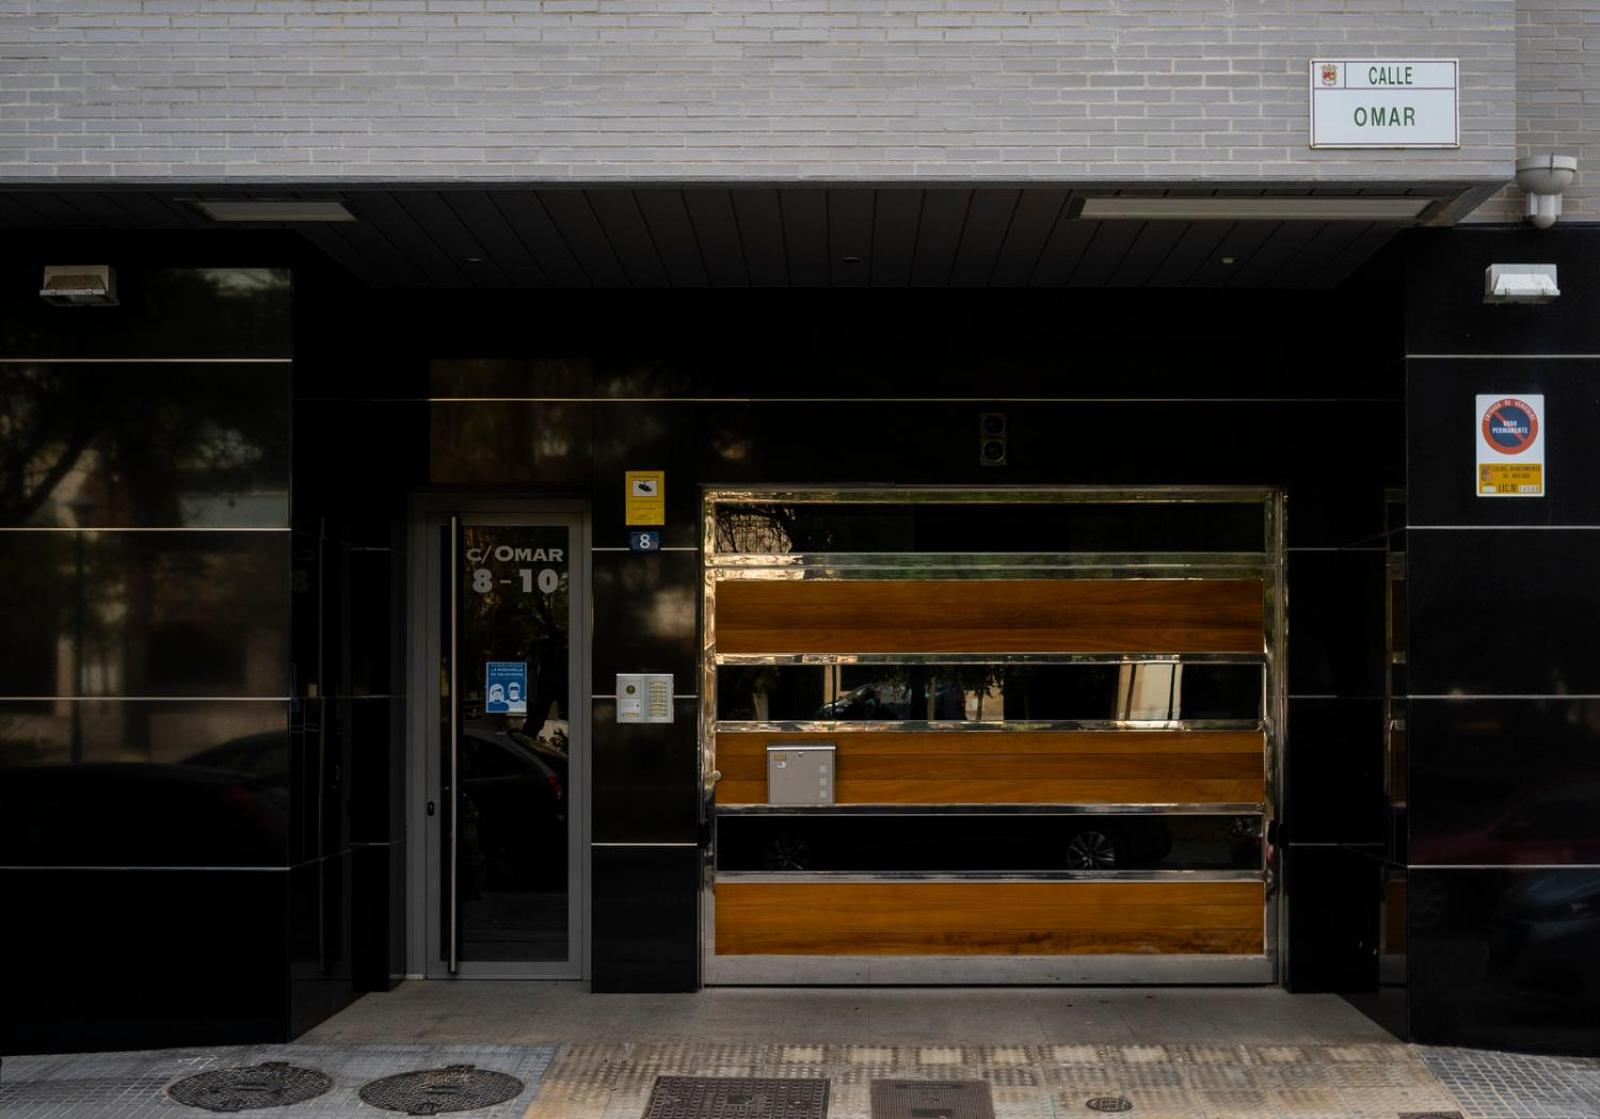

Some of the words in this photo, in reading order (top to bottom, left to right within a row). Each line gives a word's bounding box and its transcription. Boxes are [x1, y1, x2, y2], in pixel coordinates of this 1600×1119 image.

[1368, 66, 1413, 85] CALLE
[1353, 106, 1415, 127] OMAR
[639, 533, 651, 550] 8
